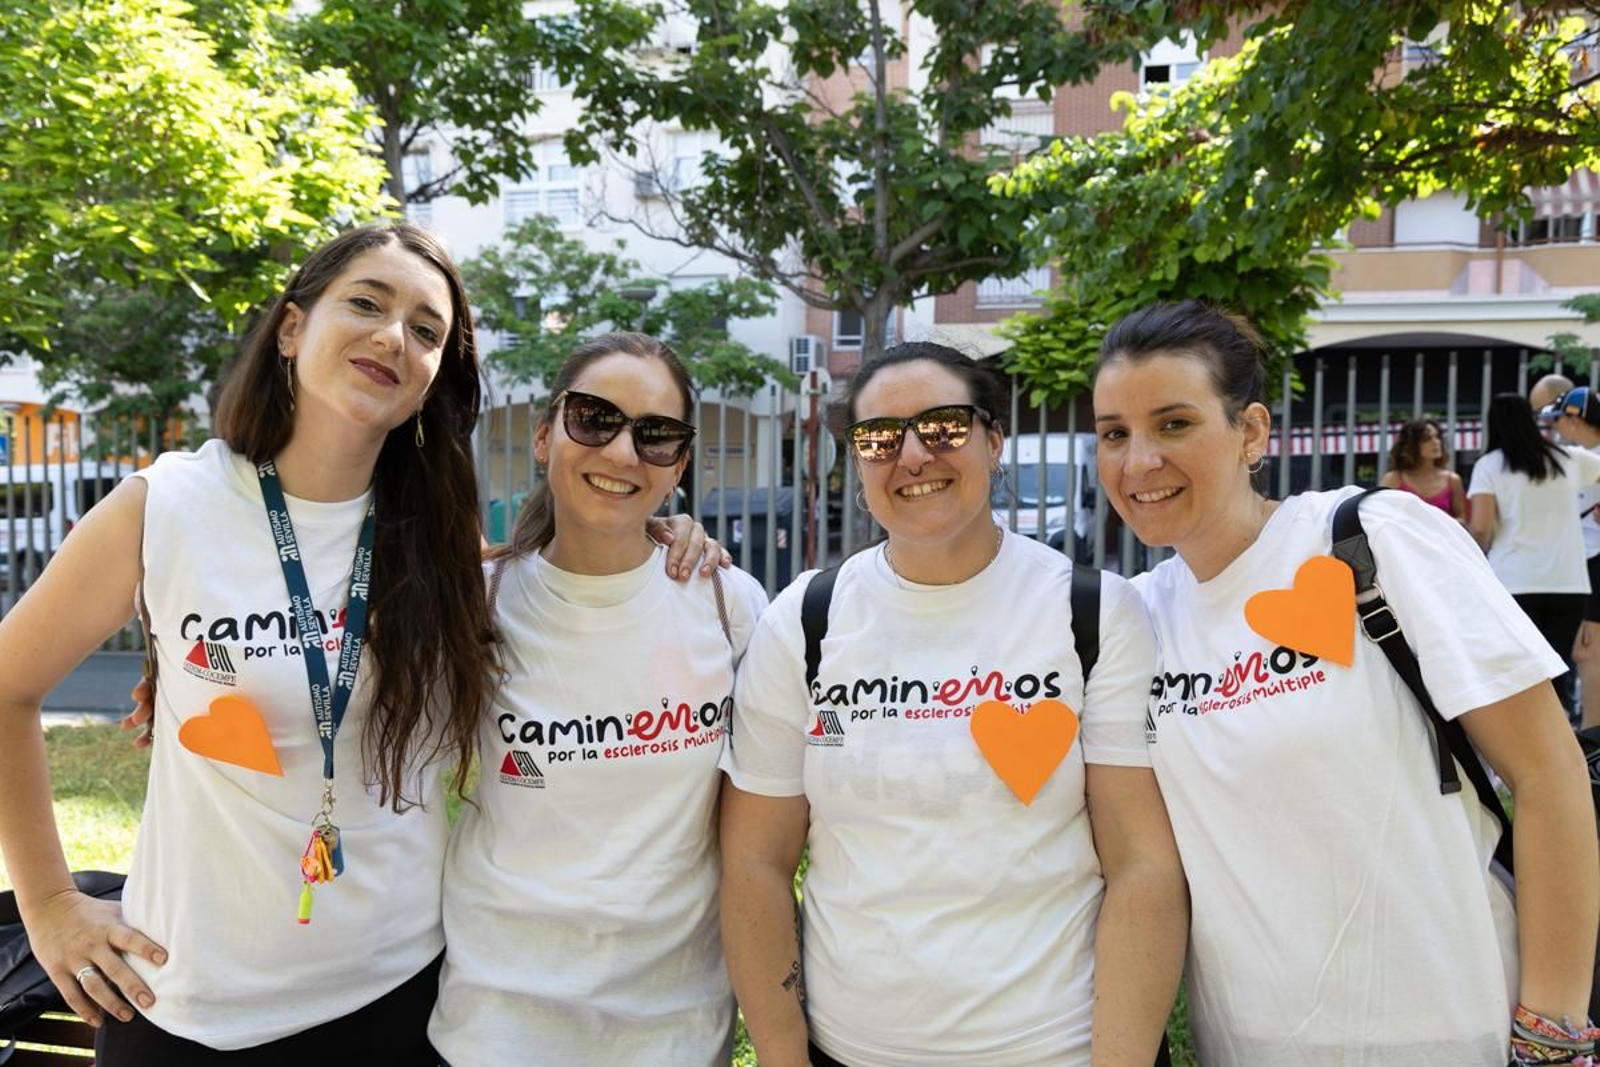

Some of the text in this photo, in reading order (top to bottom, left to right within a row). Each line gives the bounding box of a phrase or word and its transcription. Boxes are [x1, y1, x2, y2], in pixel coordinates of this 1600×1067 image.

[269, 510, 286, 545] AUTISMO
[280, 511, 295, 545] SEVILLA
[354, 547, 365, 580] AUTISMO
[362, 550, 373, 583] SEVILLA
[292, 595, 309, 631] AUTISMO
[302, 597, 317, 630] SEVILLA
[244, 644, 301, 660] por la
[341, 632, 353, 670] AUTISMO
[349, 638, 362, 672] SEVILLA
[312, 684, 325, 720] AUTISMO
[321, 686, 332, 720] SEVILLA
[851, 704, 976, 722] por la esclerosi
[1158, 702, 1177, 717] por
[1183, 704, 1198, 716] la
[548, 751, 577, 765] por
[583, 748, 598, 761] la
[604, 738, 680, 760] esclerosis
